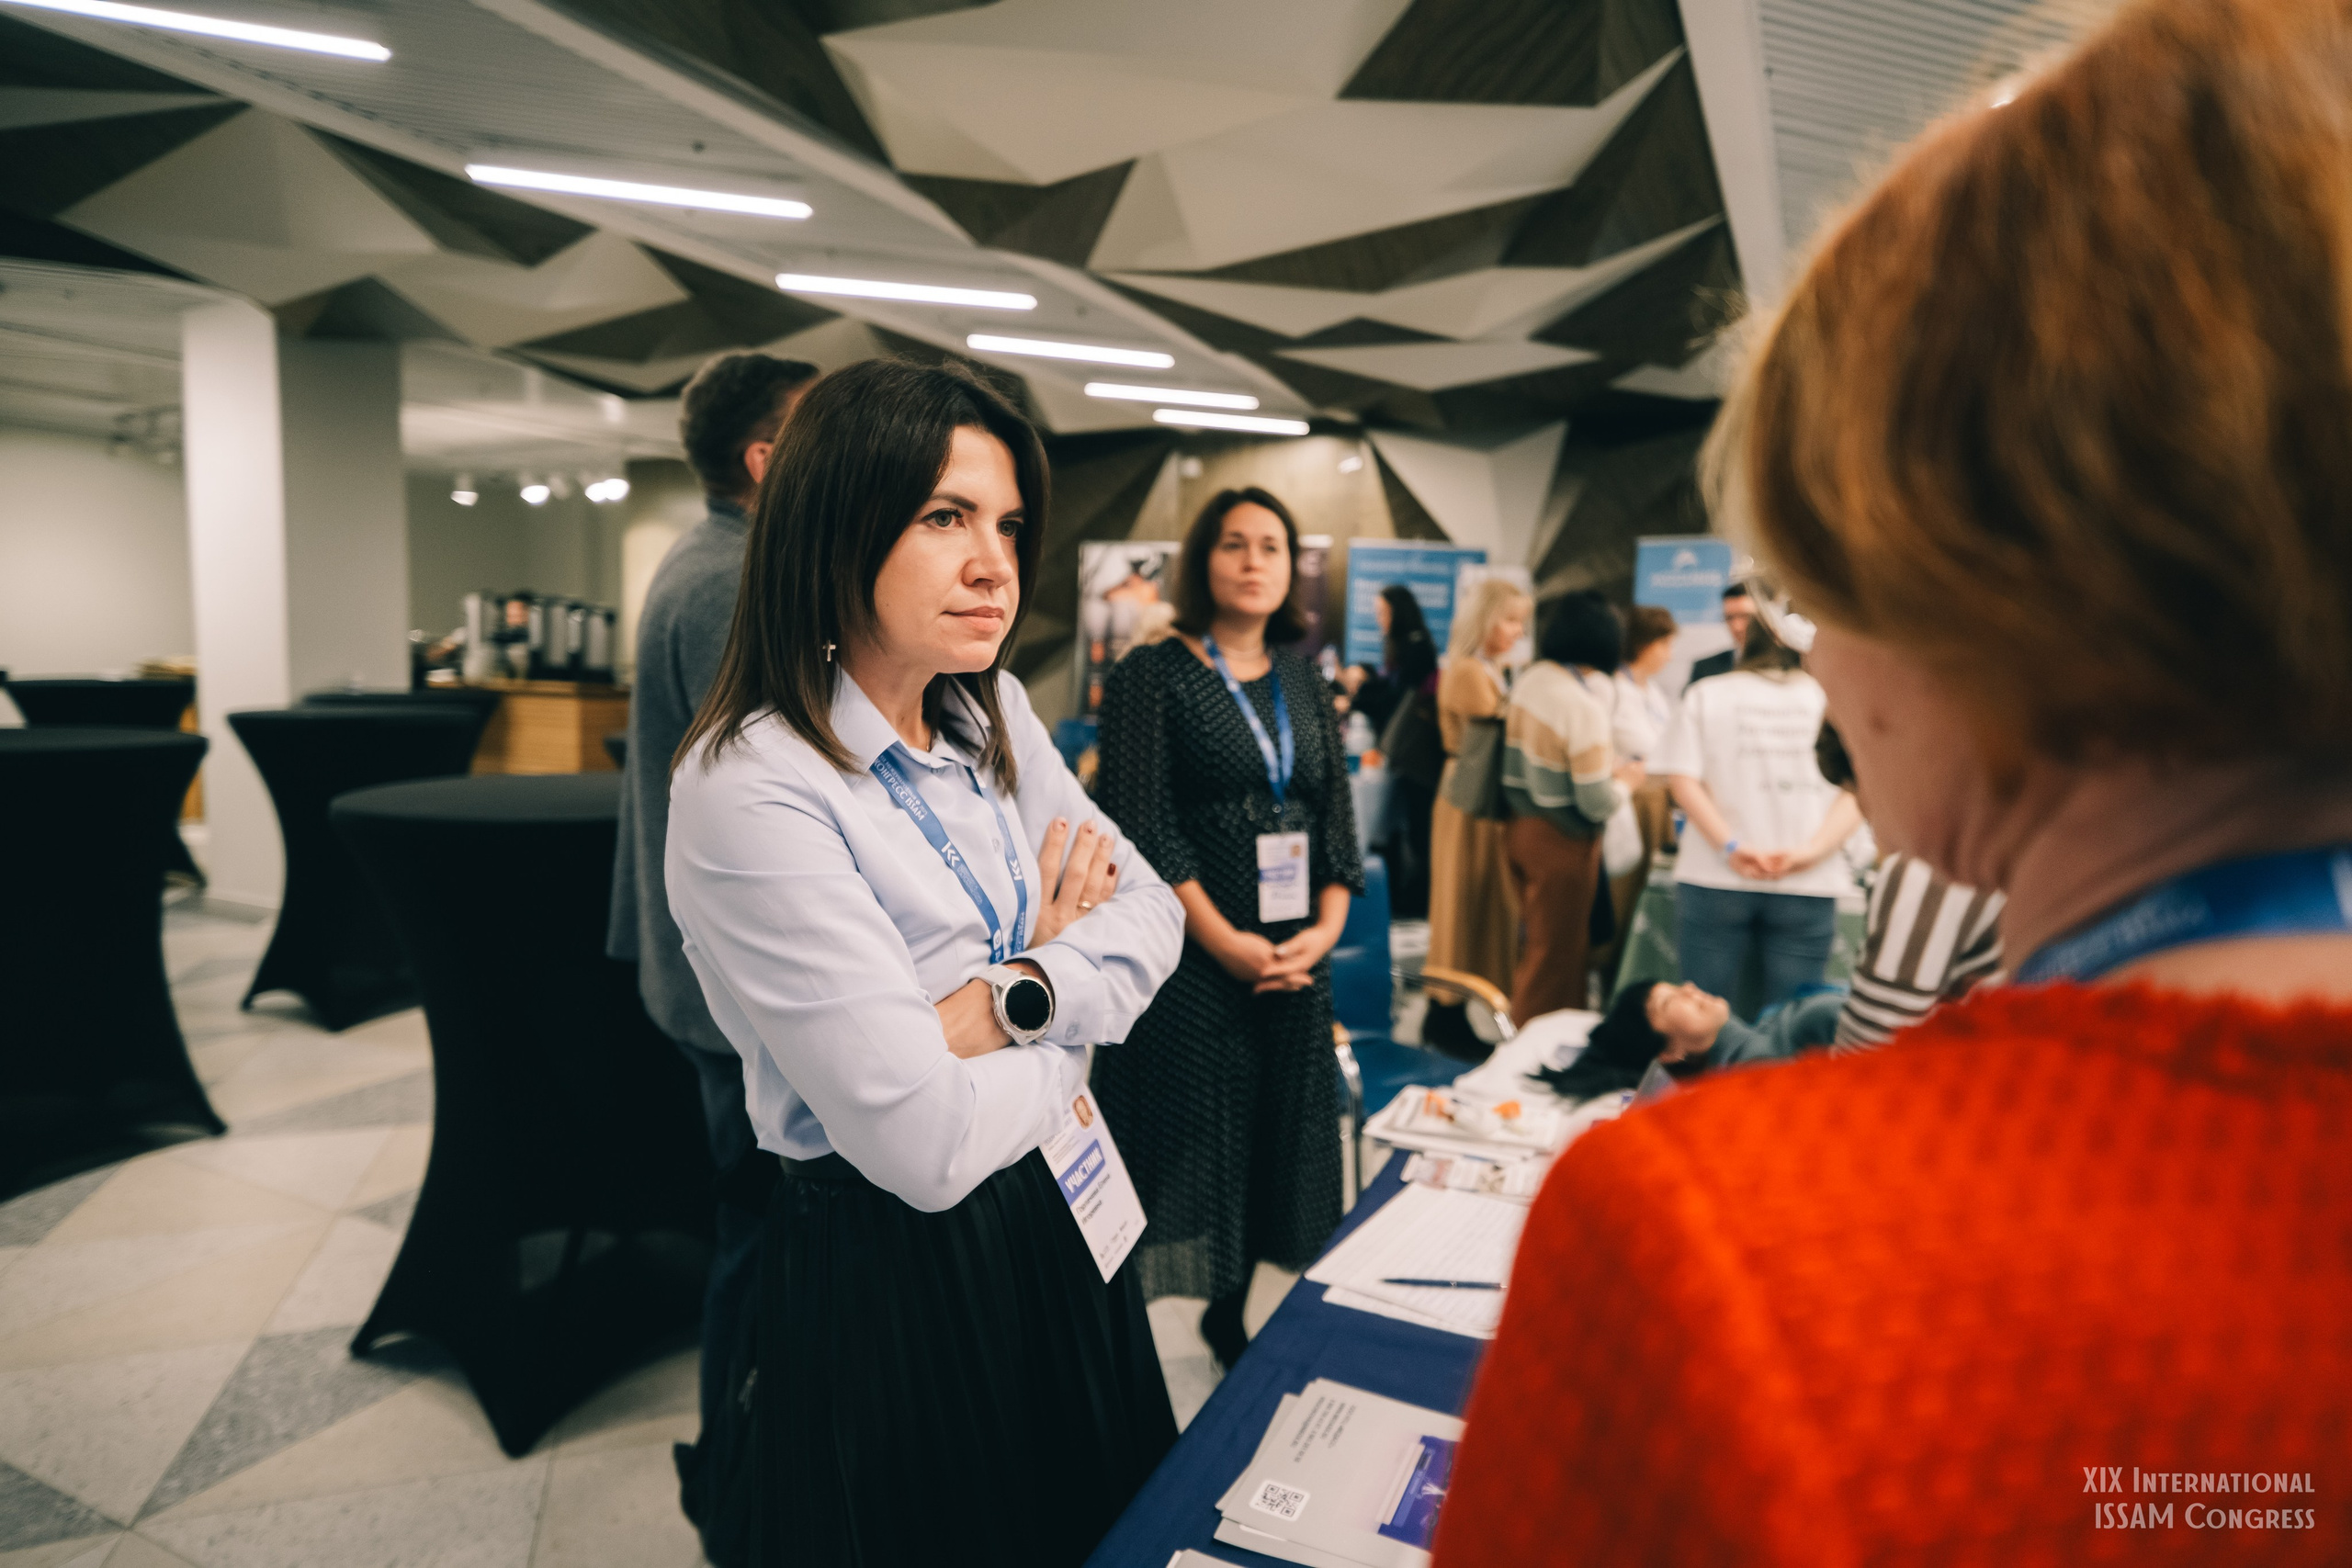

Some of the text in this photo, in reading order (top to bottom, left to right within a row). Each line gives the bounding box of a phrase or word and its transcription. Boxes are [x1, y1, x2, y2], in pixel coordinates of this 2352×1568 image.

[874, 758, 925, 821] КОНГРЕСС ISSAM
[1065, 1147, 1102, 1193] УЧАСТНИК
